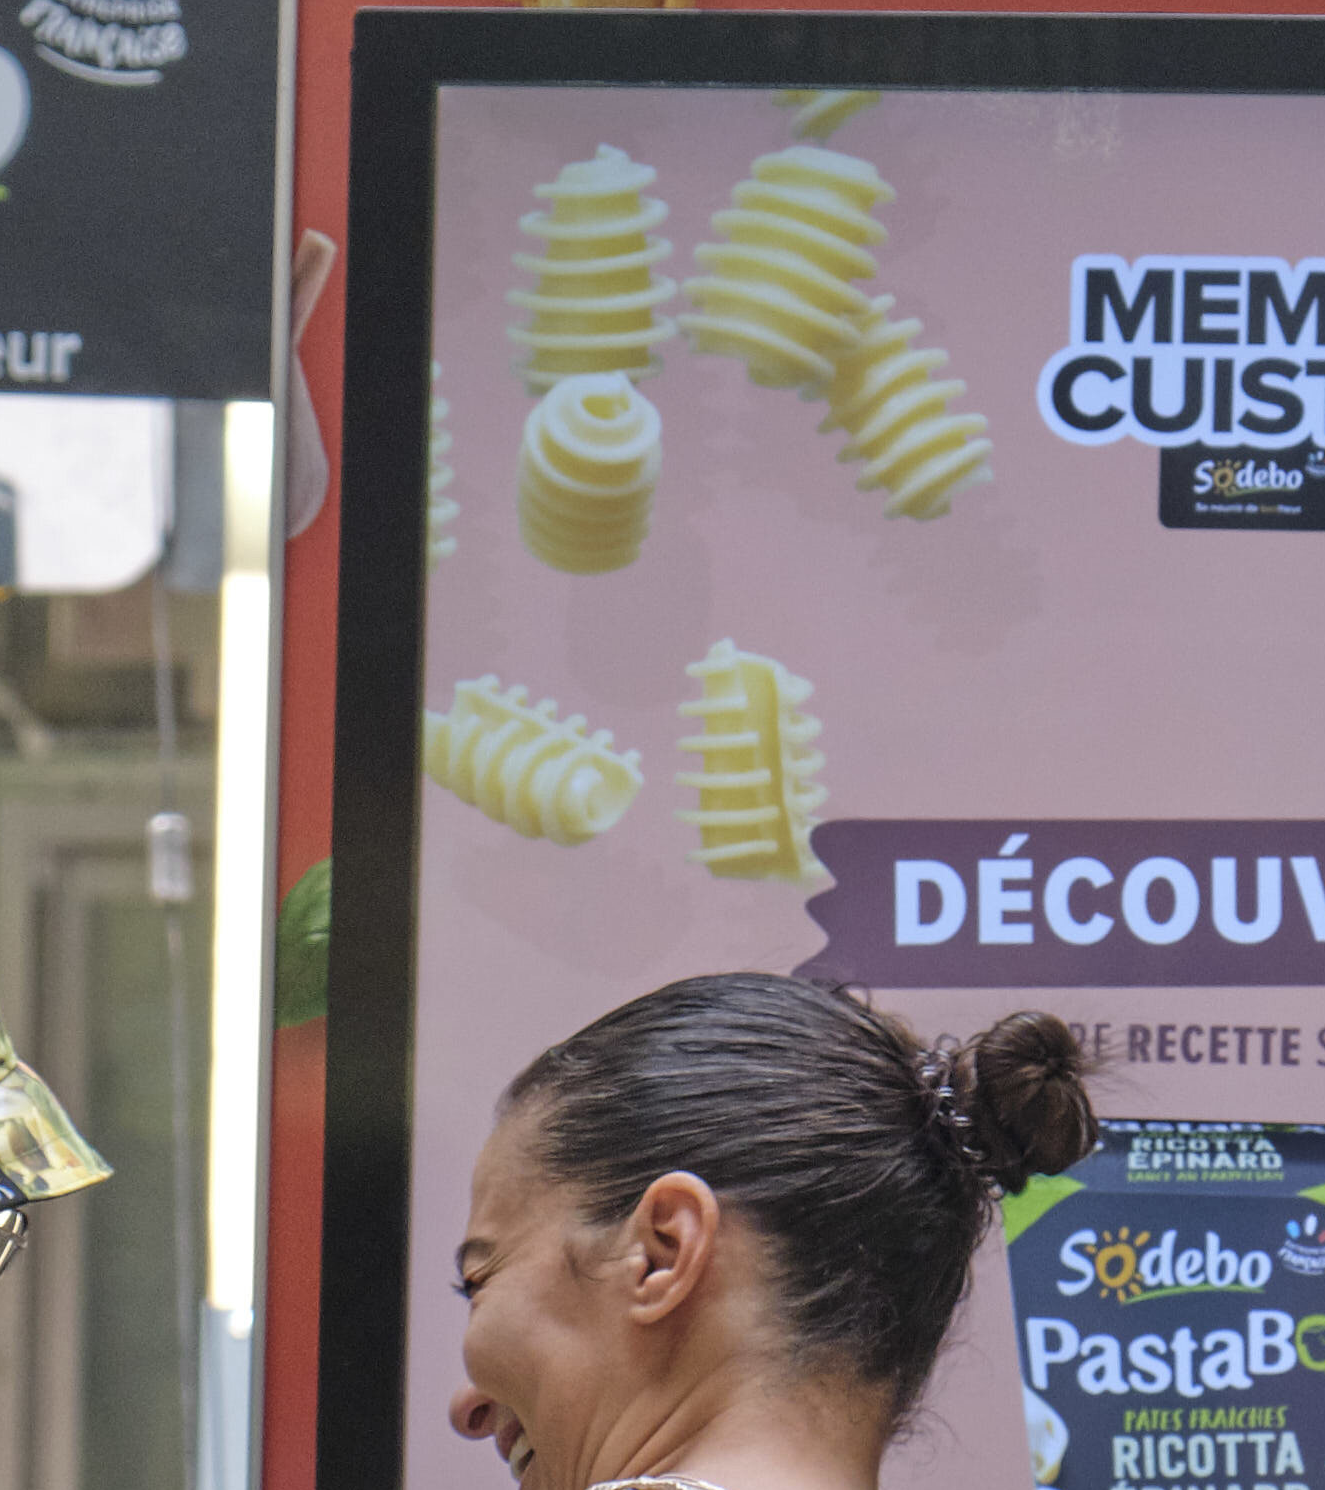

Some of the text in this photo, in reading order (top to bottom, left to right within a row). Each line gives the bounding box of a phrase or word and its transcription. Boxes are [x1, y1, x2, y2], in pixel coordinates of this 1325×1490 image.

[1193, 458, 1304, 495] Sodebo
[1127, 1024, 1303, 1070] RECETTE
[1132, 1138, 1276, 1152] RICOTTA
[1056, 1228, 1272, 1297] Sodebo
[1113, 1432, 1305, 1480] RICOTTA
